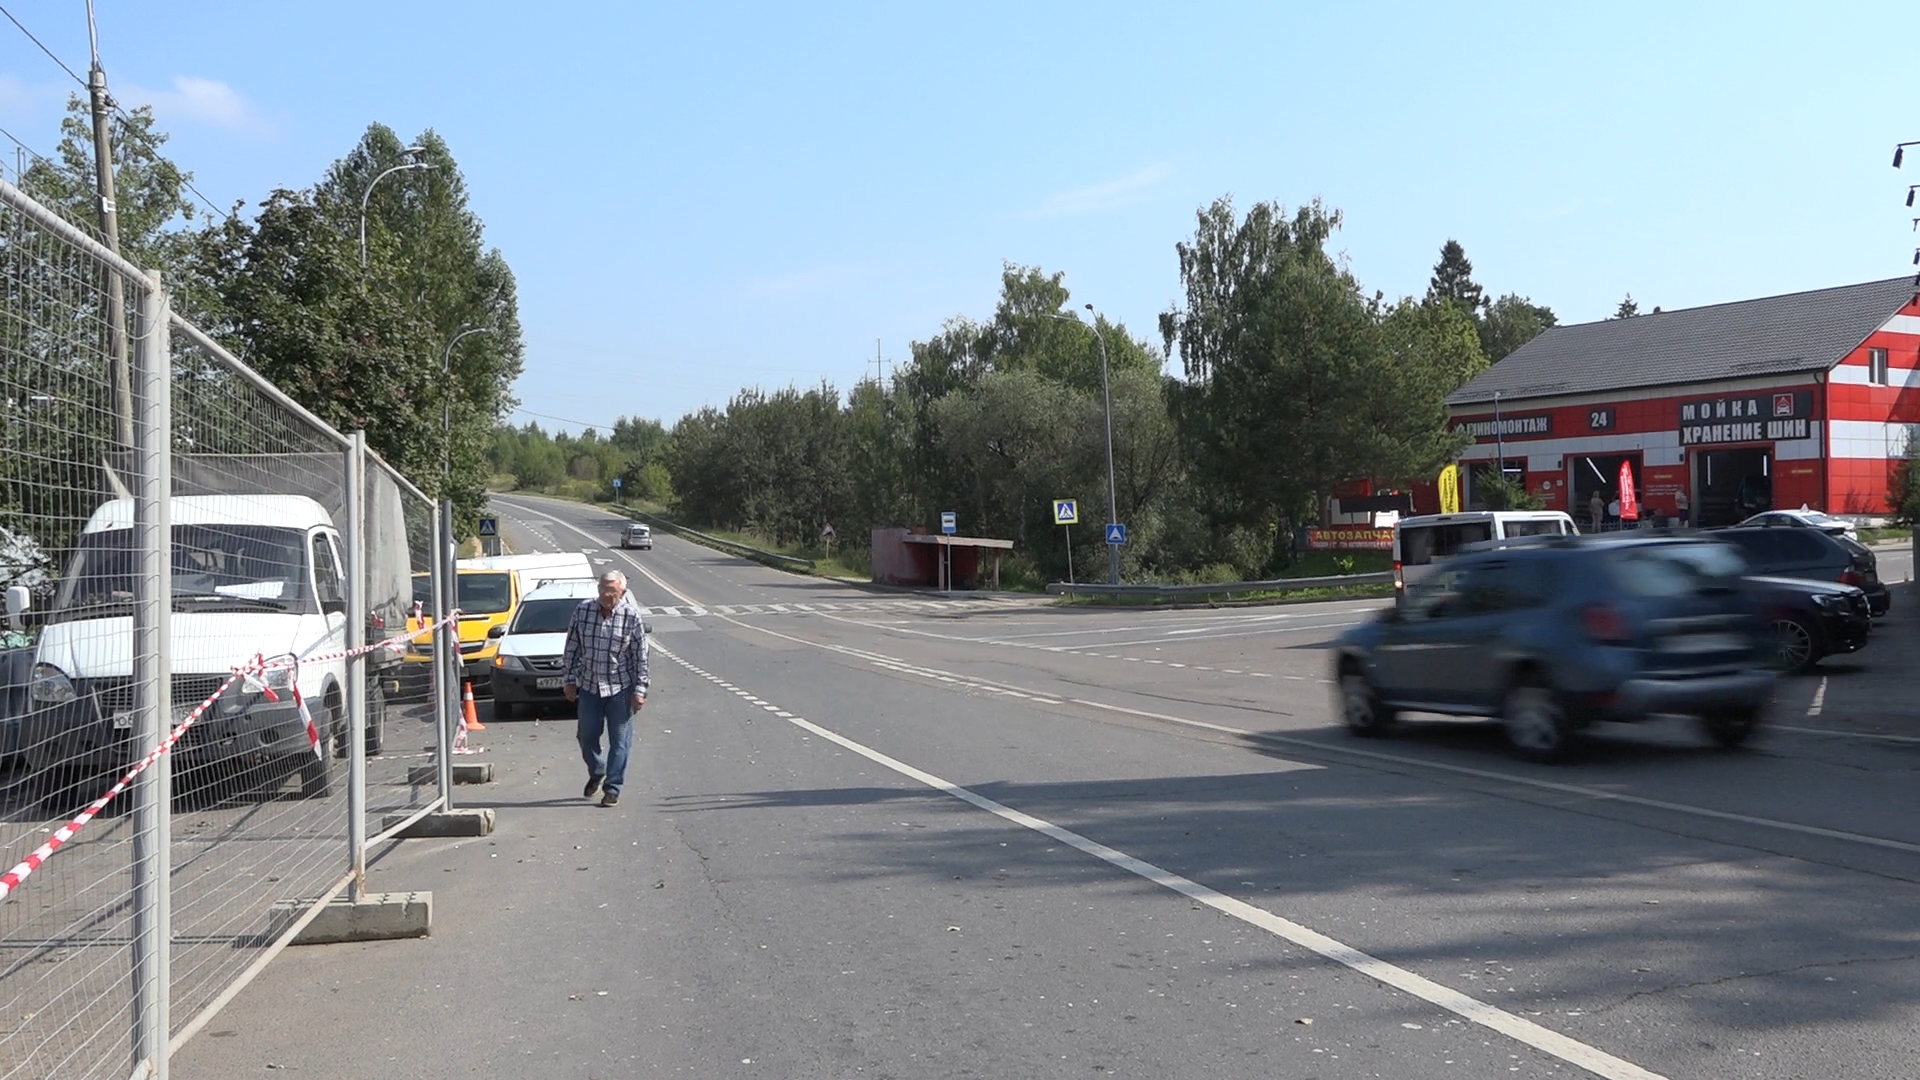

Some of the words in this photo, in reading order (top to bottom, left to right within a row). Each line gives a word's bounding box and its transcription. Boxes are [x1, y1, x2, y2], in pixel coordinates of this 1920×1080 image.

[1591, 412, 1607, 427] 24
[1683, 399, 1757, 420] МОЙКА
[1683, 422, 1761, 443] ХРАНЕНИЕ
[1767, 419, 1806, 438] ШИН
